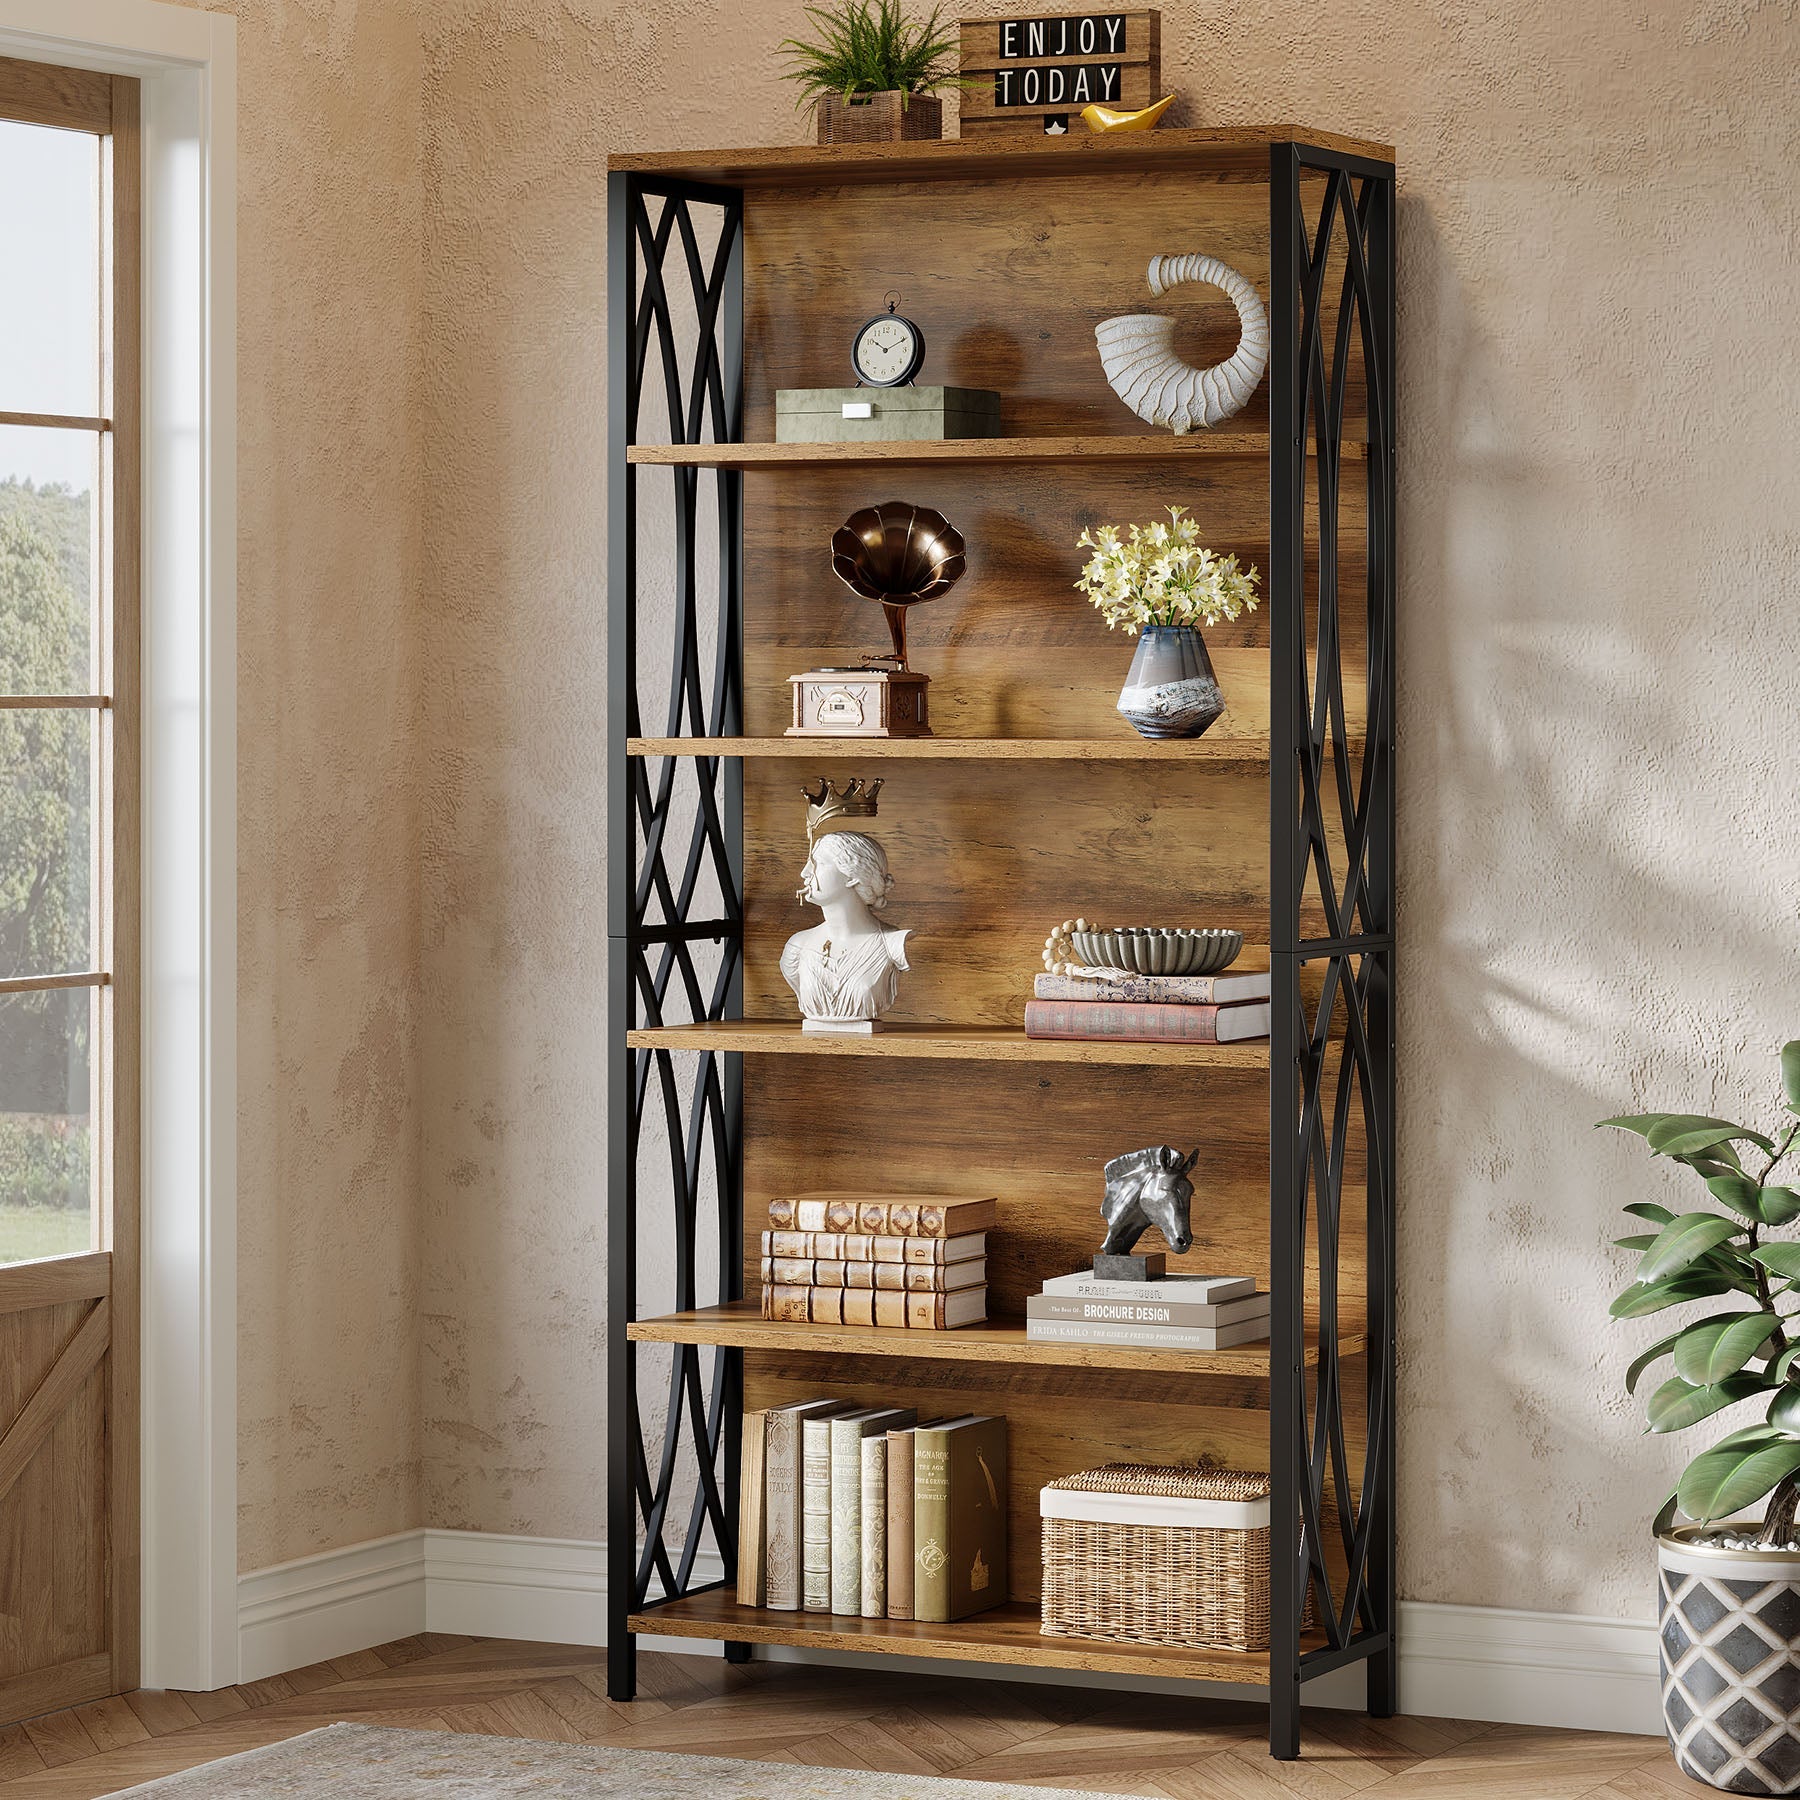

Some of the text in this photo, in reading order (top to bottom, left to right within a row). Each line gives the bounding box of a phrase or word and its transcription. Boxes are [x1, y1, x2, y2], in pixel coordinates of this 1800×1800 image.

[1004, 18, 1121, 57] ENJOY
[999, 67, 1117, 105] TODAY
[1084, 1304, 1134, 1319] BROCHURE
[1136, 1307, 1170, 1321] DESIGN
[1033, 1326, 1057, 1336] FRIDA
[1060, 1327, 1088, 1337] KAHLO
[917, 1493, 948, 1501] DONNELLY
